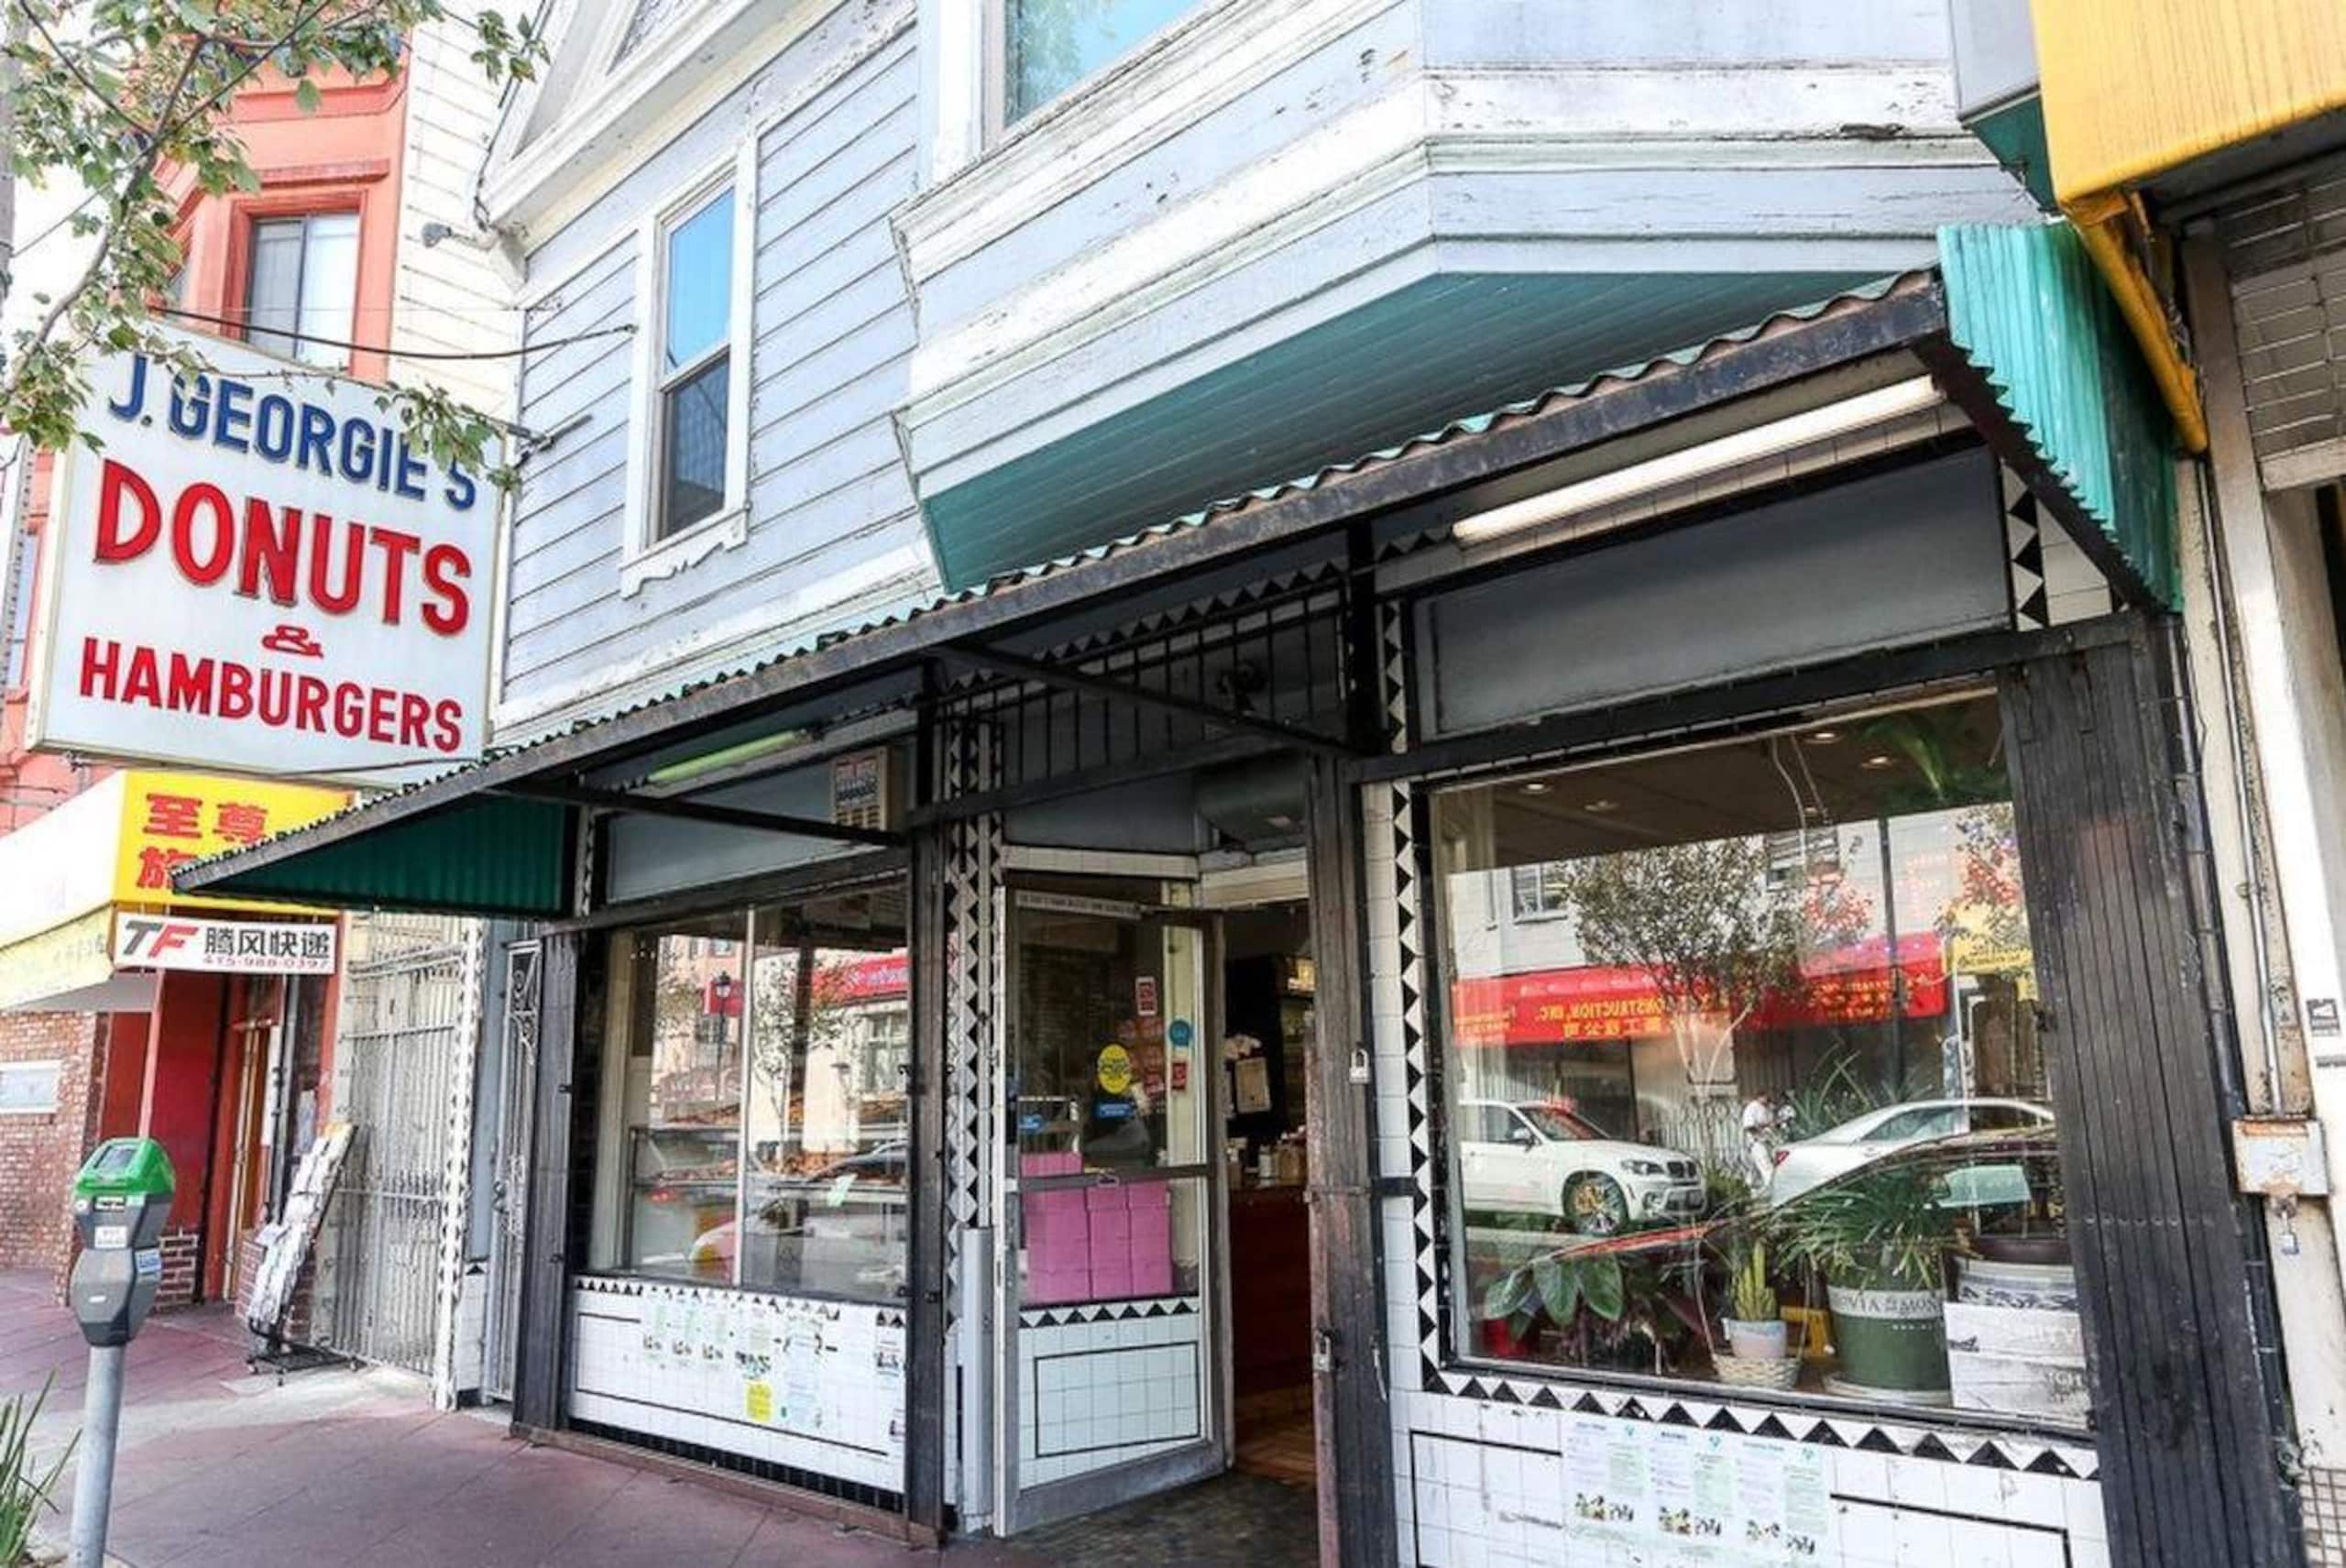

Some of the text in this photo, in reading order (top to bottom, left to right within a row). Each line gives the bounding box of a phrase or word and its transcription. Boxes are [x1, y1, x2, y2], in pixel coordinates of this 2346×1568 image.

[170, 371, 476, 511] GEORGIES
[93, 458, 472, 636] DONUTS
[262, 624, 323, 658] &
[80, 636, 462, 752] HAMBURGERS
[123, 920, 199, 958] TF
[204, 926, 330, 959] 腾风快递
